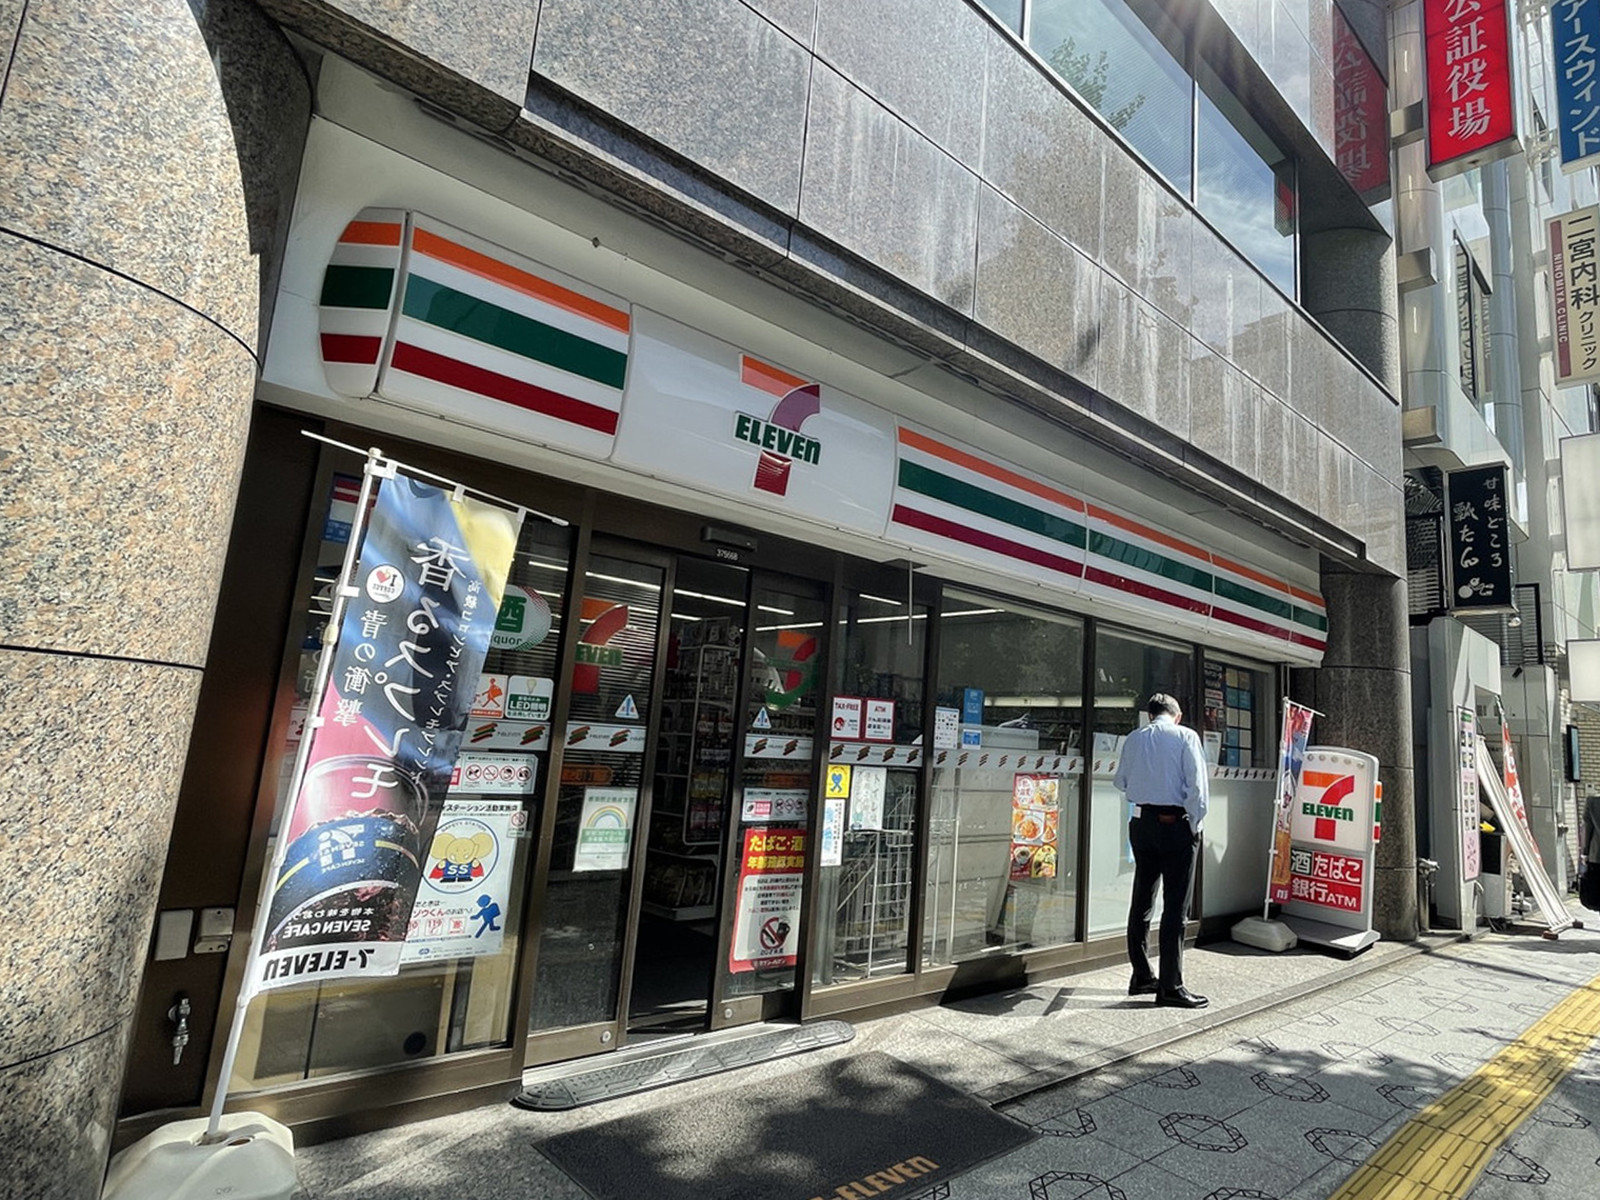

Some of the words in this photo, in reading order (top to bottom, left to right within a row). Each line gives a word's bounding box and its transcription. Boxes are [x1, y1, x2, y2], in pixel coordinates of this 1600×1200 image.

[1553, 253, 1565, 306] NINOMIYA
[1556, 307, 1568, 343] CLINIC
[735, 414, 821, 466] ELEVEN
[1483, 477, 1504, 568] 甘味どころ
[1302, 802, 1354, 822] ELEVEN
[447, 864, 469, 875] SS
[1291, 849, 1311, 873] 酒
[1314, 855, 1361, 882] たばこ
[808, 1155, 940, 1200] -ELEVEN
